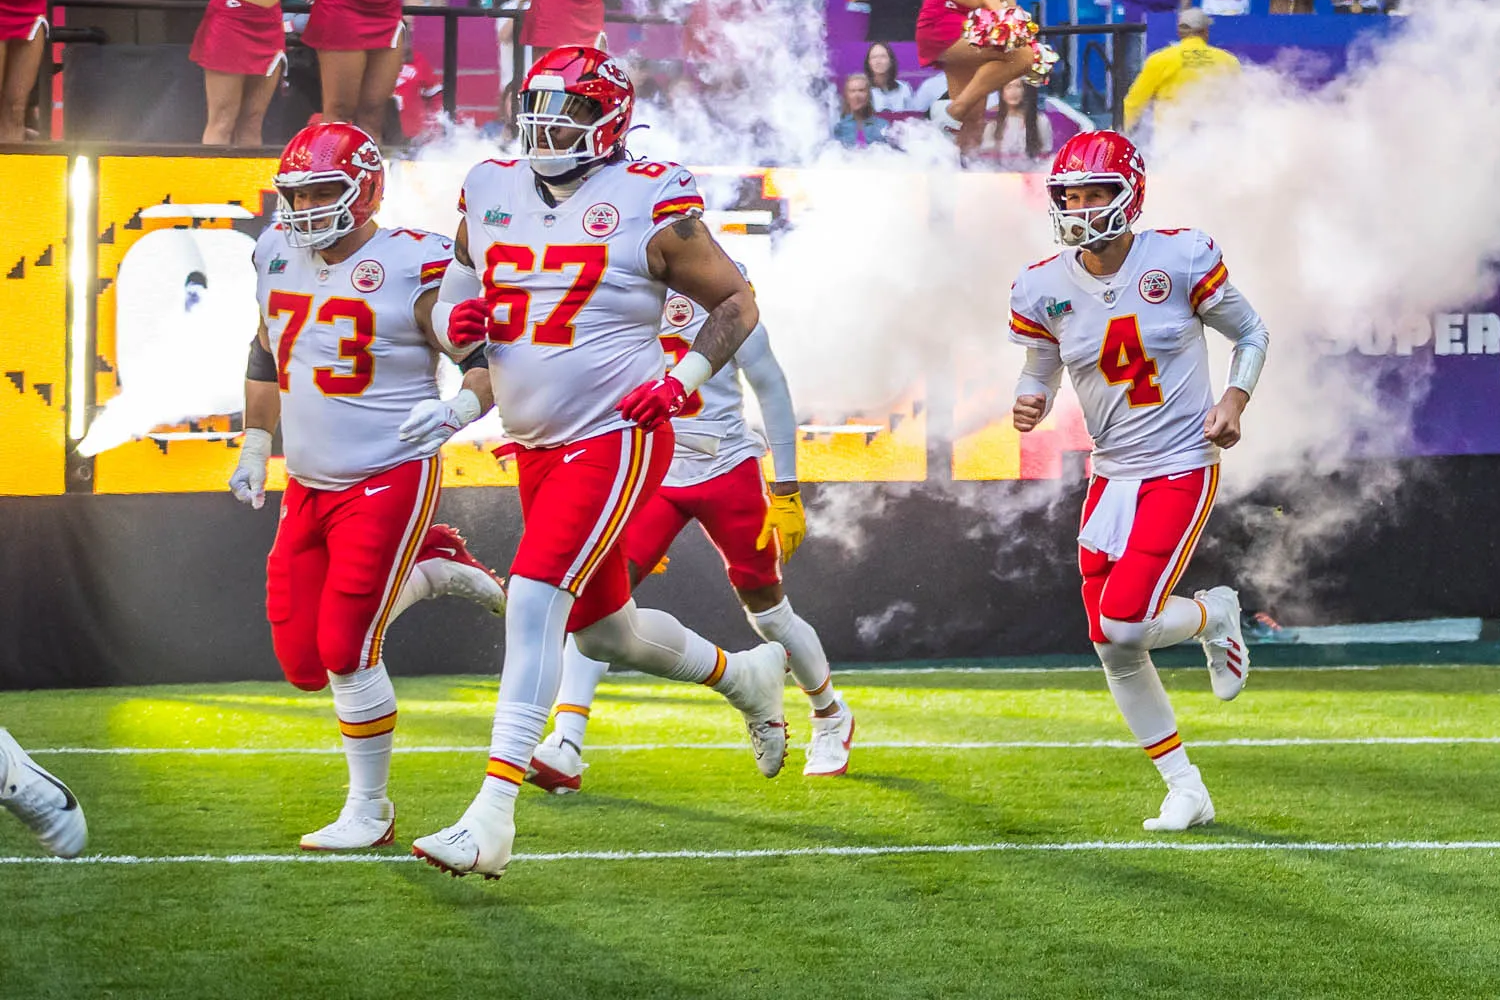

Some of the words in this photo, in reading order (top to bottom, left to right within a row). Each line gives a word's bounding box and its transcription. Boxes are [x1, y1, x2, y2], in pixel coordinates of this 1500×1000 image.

[267, 289, 377, 397] 73
[482, 241, 609, 348] 67
[1097, 313, 1164, 409] 4
